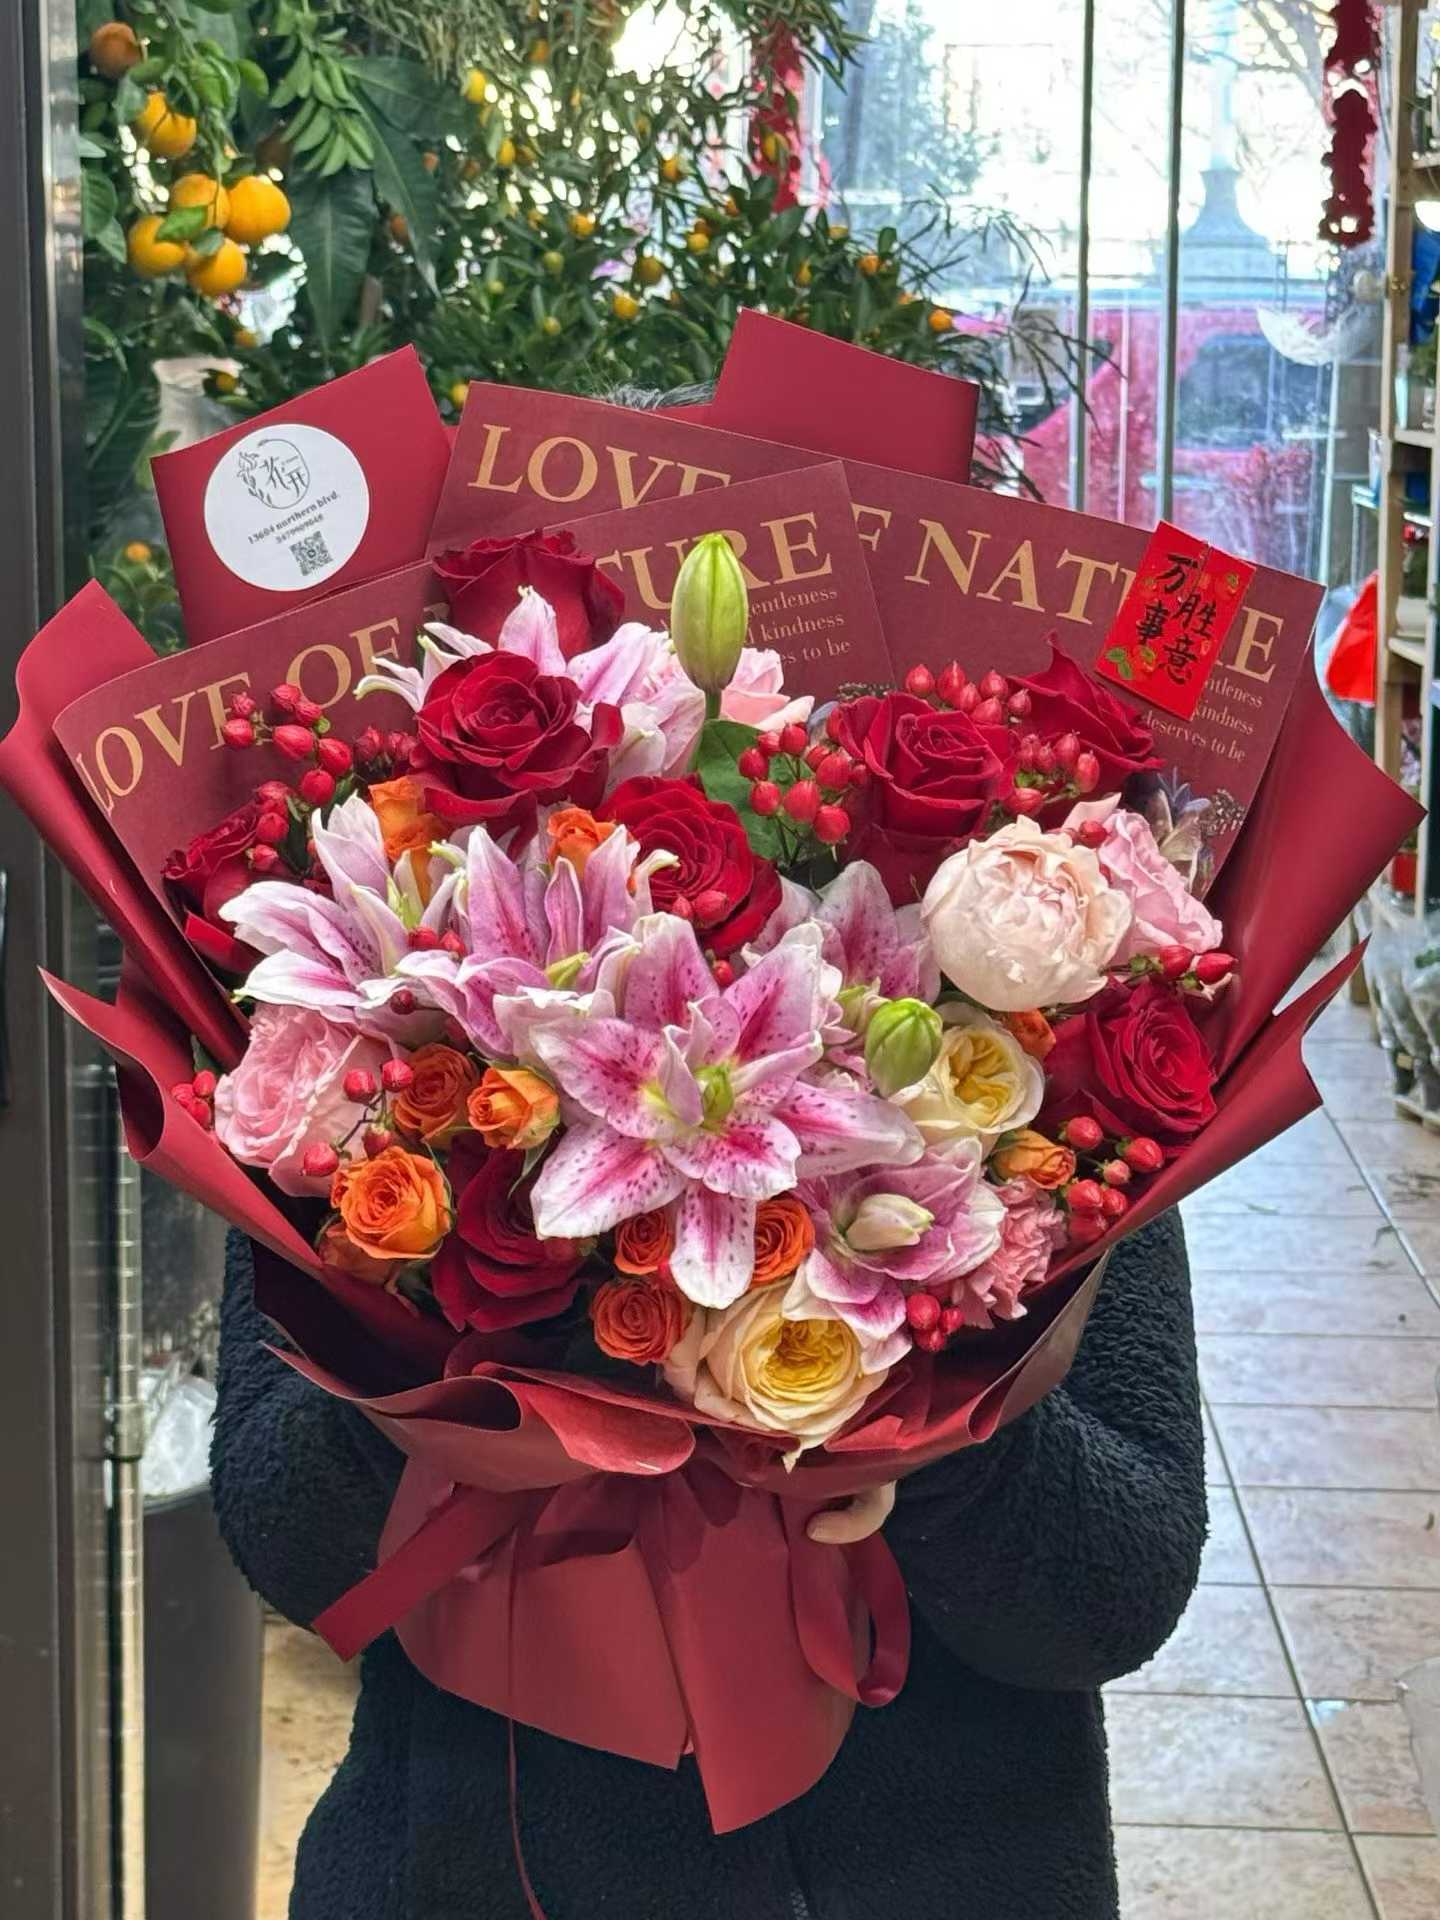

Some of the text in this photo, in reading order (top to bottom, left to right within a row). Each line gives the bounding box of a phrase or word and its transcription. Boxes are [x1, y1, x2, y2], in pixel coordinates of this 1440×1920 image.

[750, 590, 838, 617] entleness
[903, 517, 1285, 684] NATE
[760, 615, 845, 642] kindness
[803, 646, 822, 661] to
[826, 637, 851, 657] be
[1211, 737, 1226, 755] to
[1228, 739, 1246, 762] be
